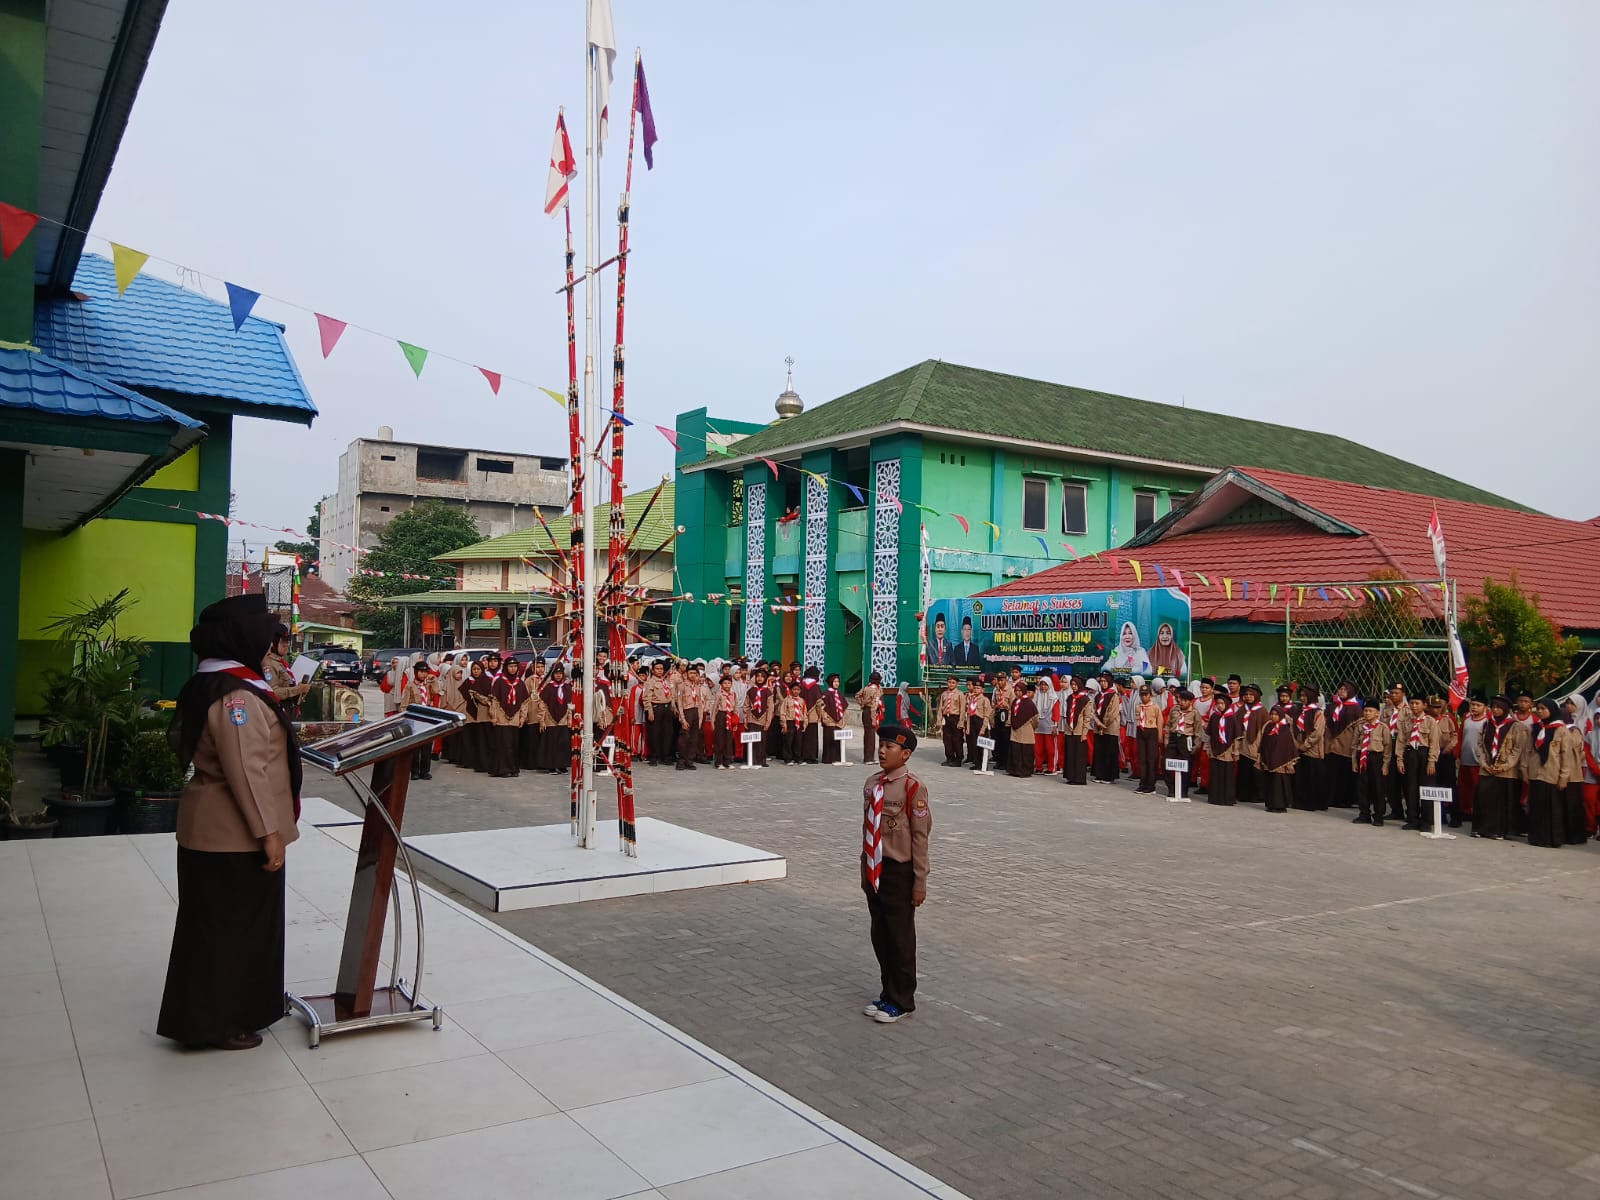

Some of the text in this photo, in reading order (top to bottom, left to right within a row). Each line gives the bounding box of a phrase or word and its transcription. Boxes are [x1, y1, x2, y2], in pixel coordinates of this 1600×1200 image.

[1002, 599, 1039, 612] Selamat
[1049, 597, 1083, 610] Sukses
[981, 615, 1009, 630] UJIAN
[1011, 613, 1071, 630] MADRASAH
[994, 632, 1016, 643] MTsN
[1017, 633, 1021, 642] 1
[1023, 632, 1044, 643] KOTA
